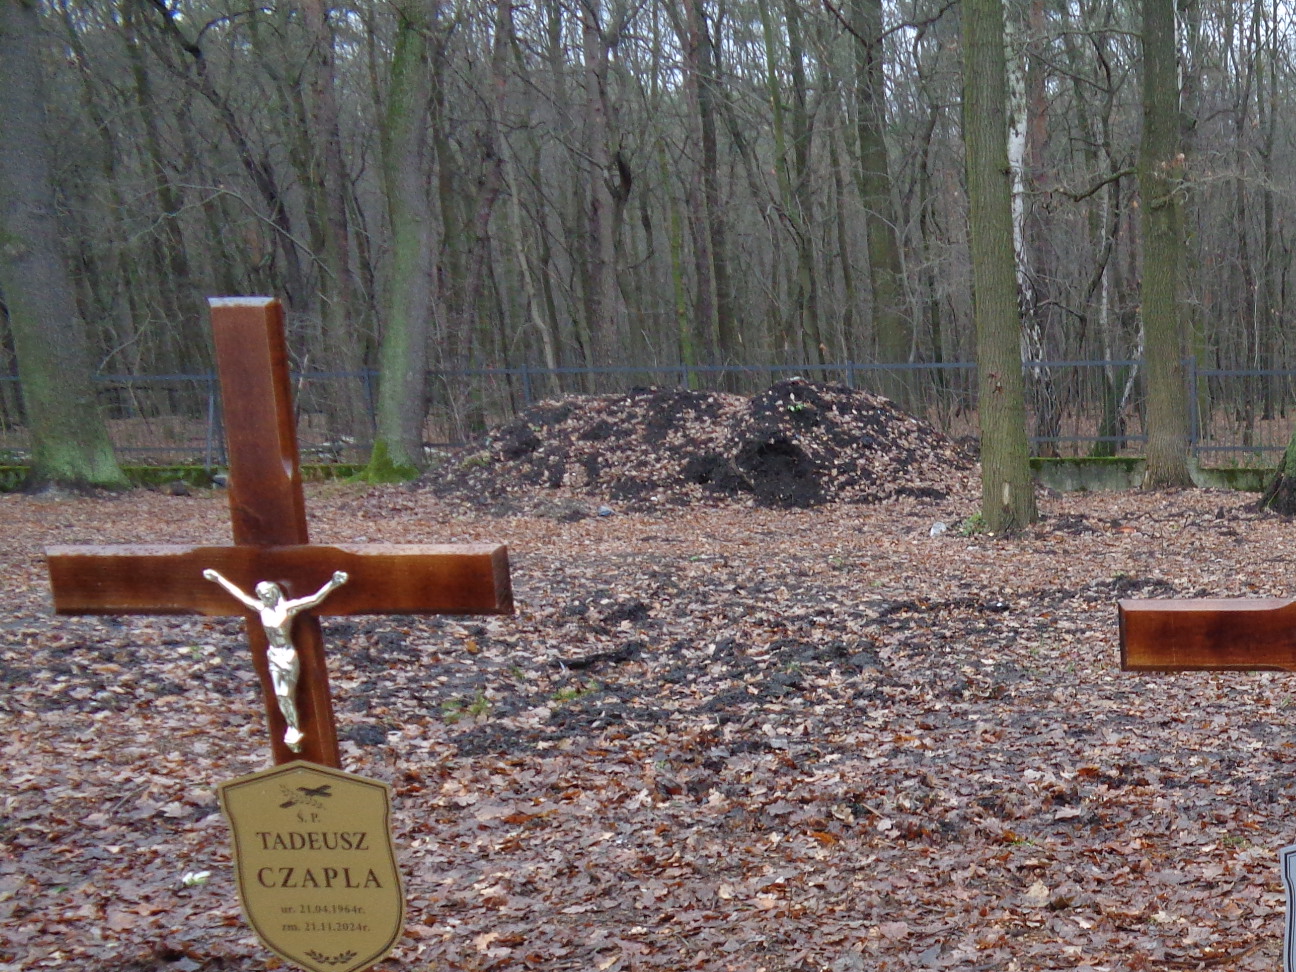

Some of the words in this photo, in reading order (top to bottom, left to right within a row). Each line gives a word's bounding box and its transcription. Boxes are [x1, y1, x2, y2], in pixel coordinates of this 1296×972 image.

[256, 831, 369, 851] TADEUSZ
[256, 866, 384, 889] CZAPLA
[280, 905, 296, 914] ur.
[281, 923, 301, 932] zm.
